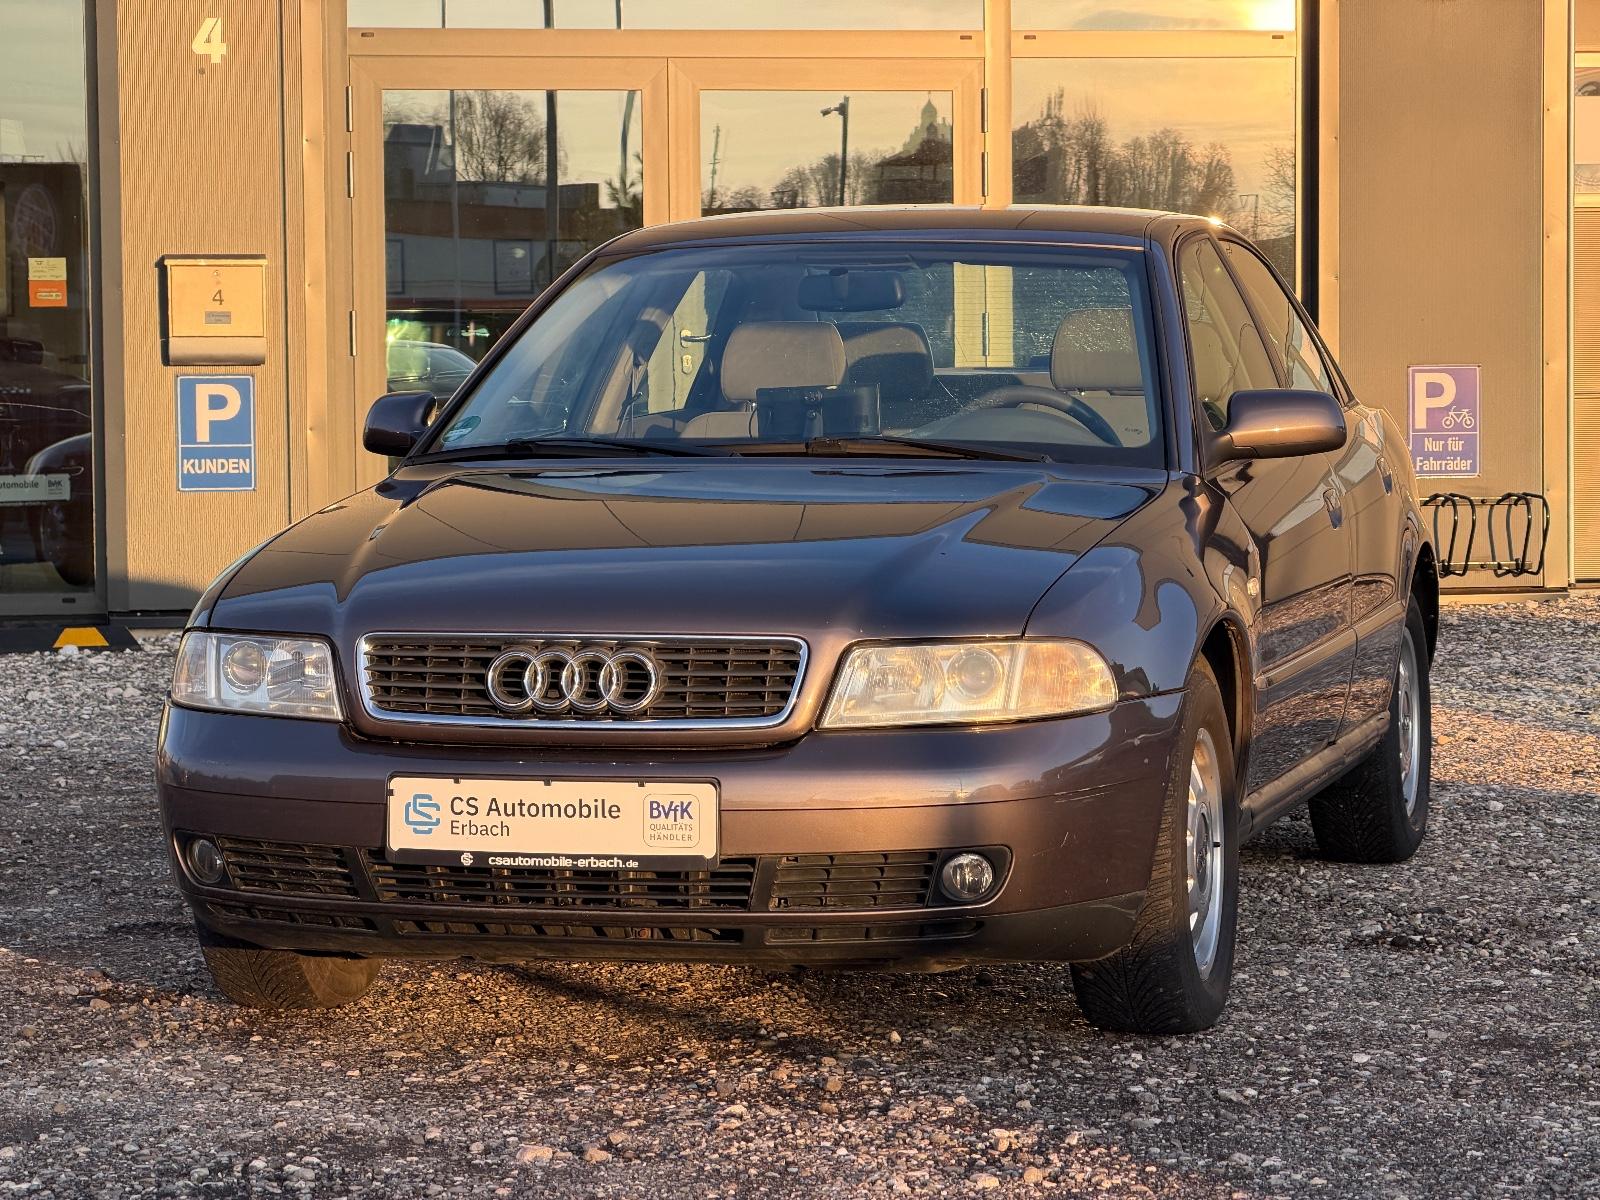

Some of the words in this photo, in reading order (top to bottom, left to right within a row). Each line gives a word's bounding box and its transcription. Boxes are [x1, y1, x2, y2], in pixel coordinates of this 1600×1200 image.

[191, 17, 227, 64] 4
[212, 289, 225, 306] 4
[1414, 372, 1457, 429] P
[195, 383, 241, 443] P
[1424, 438, 1445, 452] Nur
[1447, 437, 1465, 452] für
[183, 458, 251, 474] KUNDEN
[1416, 457, 1473, 471] Fahrräder
[450, 796, 479, 816] CS
[486, 797, 621, 819] Automobile
[450, 819, 510, 837] Erbach
[649, 822, 693, 832] QUALITÄTS
[649, 832, 693, 841] HÄNDLER
[488, 855, 639, 869] csautomobile-erbach.de
